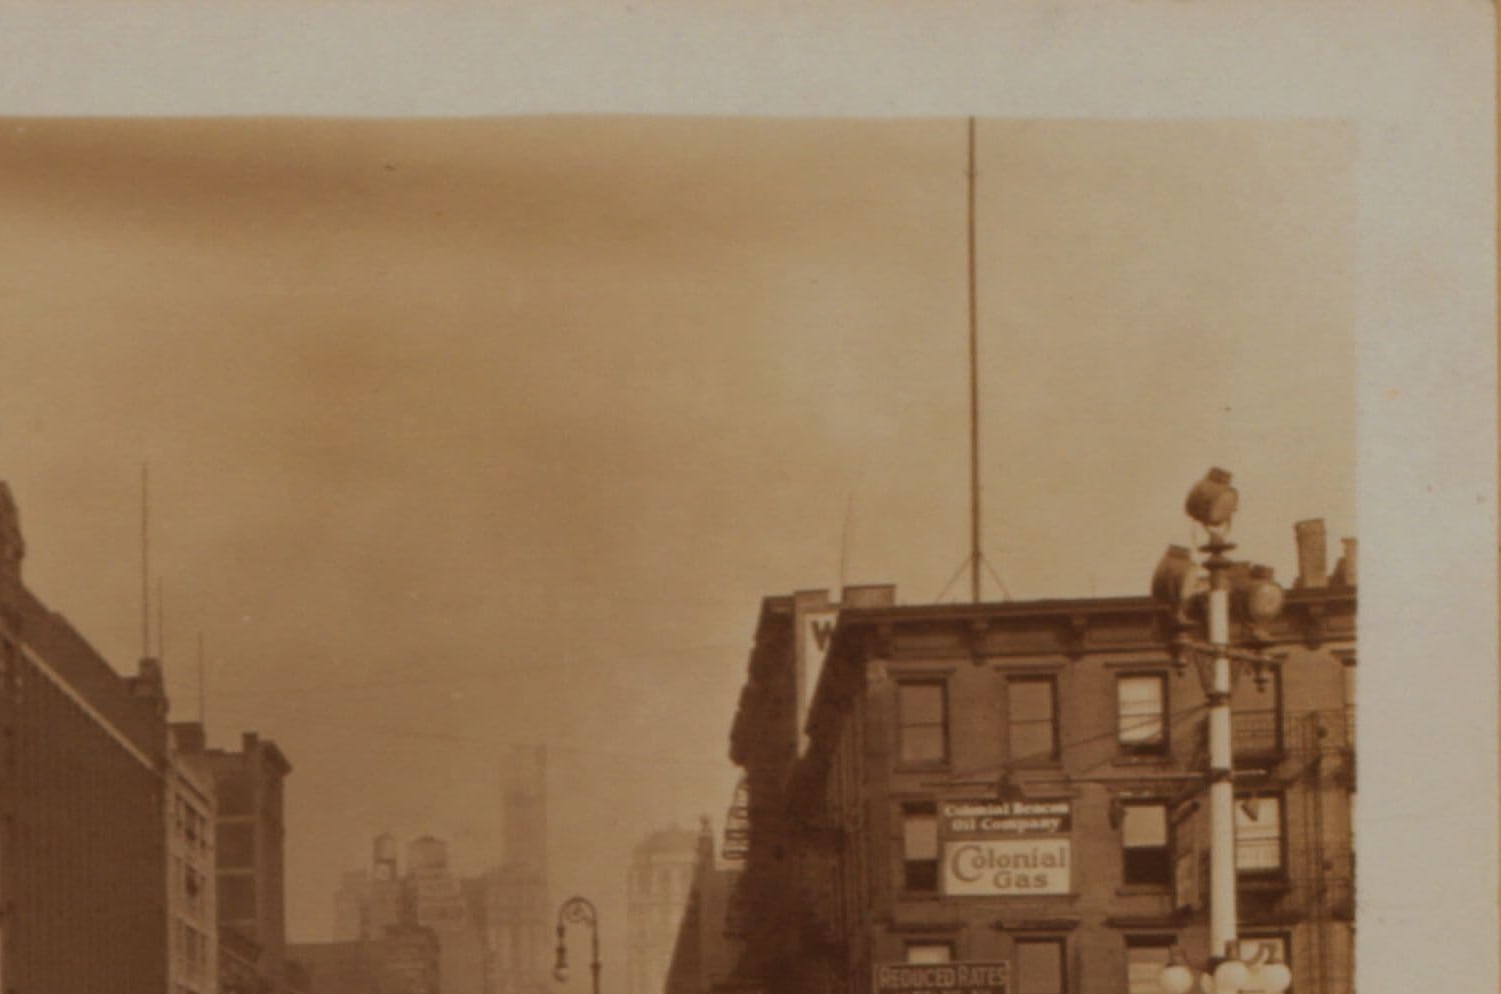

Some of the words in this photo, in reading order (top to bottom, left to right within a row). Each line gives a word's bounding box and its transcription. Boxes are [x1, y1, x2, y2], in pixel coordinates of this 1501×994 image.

[951, 818, 976, 832] Oil
[980, 817, 1061, 833] Company
[951, 844, 1066, 883] Colonial
[992, 870, 1048, 889] Gas
[879, 967, 956, 988] REDUCED
[957, 965, 1007, 987] RATES
